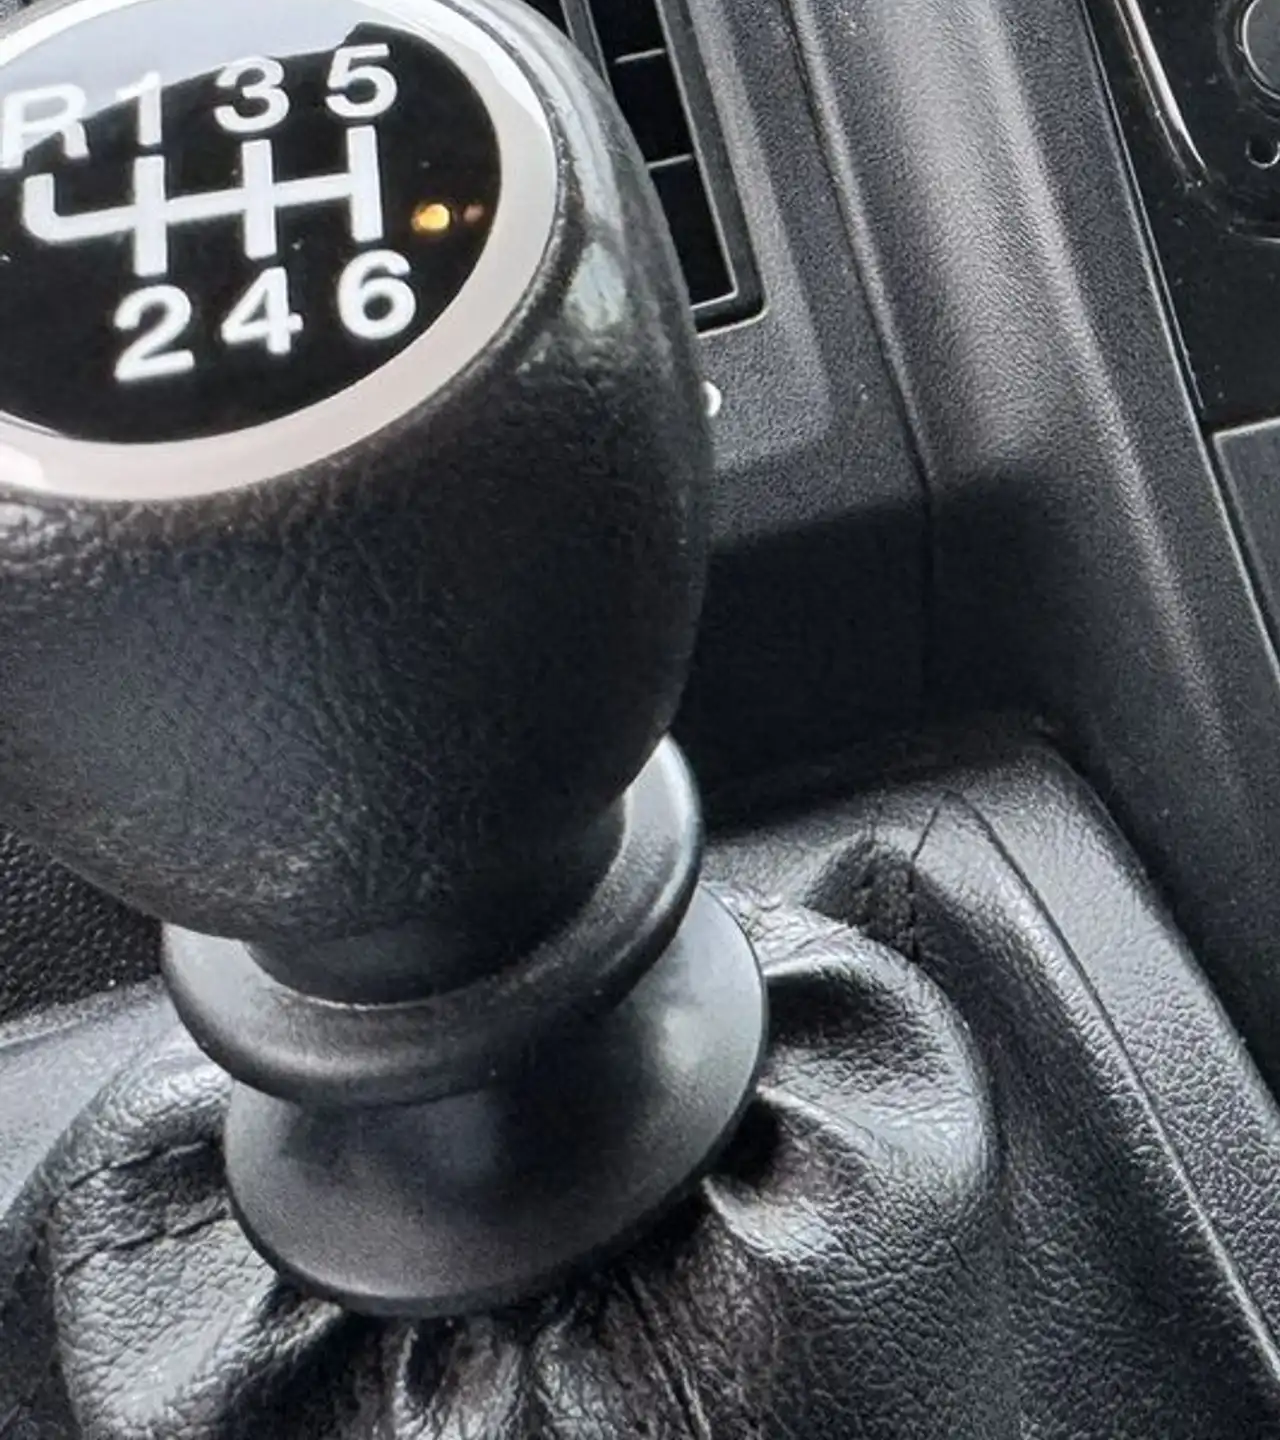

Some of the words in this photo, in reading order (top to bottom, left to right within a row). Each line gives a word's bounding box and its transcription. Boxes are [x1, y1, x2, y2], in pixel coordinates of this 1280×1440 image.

[1, 83, 90, 172] R
[116, 71, 162, 147] 1
[213, 56, 290, 133] 3
[325, 43, 398, 119] 5
[113, 284, 196, 382] 2
[220, 265, 304, 355] 4
[337, 248, 416, 340] 6
